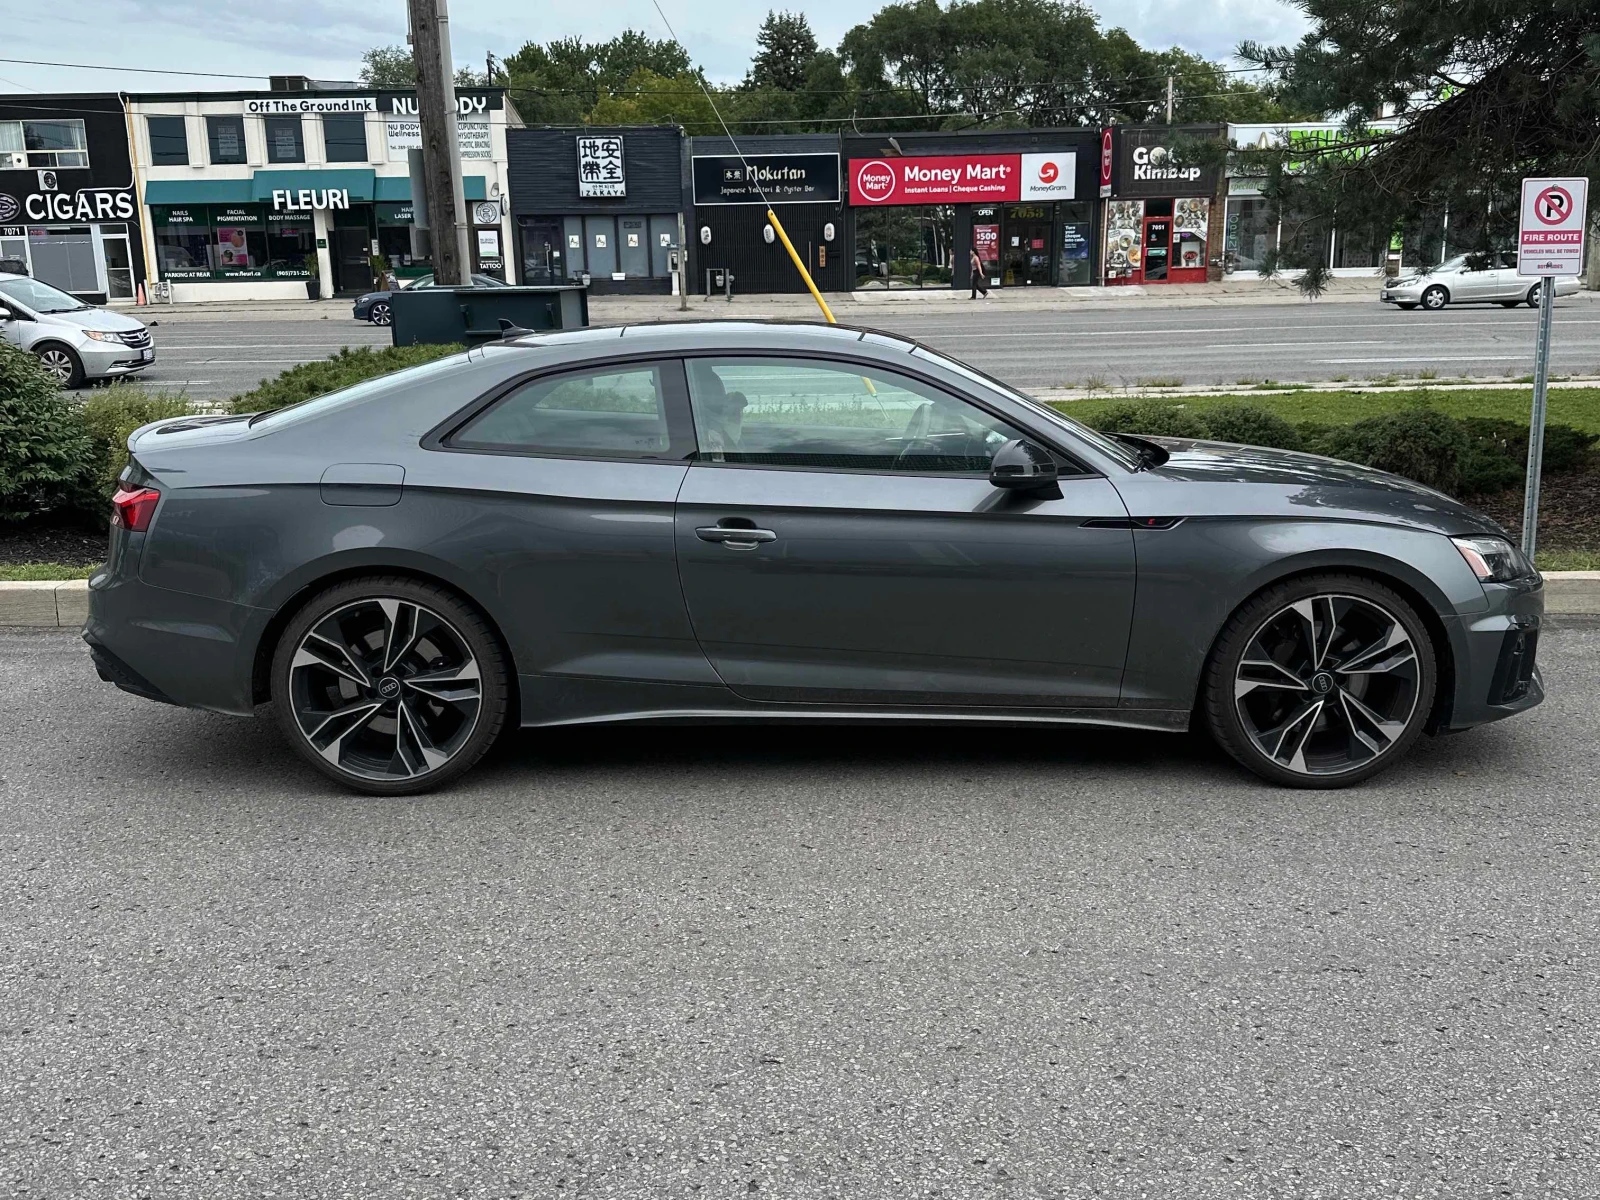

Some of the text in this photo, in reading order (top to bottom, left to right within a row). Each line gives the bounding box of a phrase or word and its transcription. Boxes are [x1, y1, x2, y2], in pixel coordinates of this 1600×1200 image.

[249, 99, 372, 112] Off The Ground Ink
[458, 123, 489, 131] CUPUNCTURE
[388, 130, 420, 138] Wellness
[746, 165, 806, 181] Mokutan
[904, 166, 961, 184] Money
[1134, 164, 1201, 181] Kimbap
[863, 174, 891, 183] Money
[720, 186, 746, 196] Japanese
[783, 186, 802, 194] Oyster
[904, 184, 1006, 194] Instant Loans Cheque Cashing
[272, 188, 350, 210] FLEURI
[26, 193, 134, 220] CIGARS
[3, 227, 20, 236] 7071
[976, 232, 997, 241] $500
[1523, 233, 1579, 242] FIRE ROUTE
